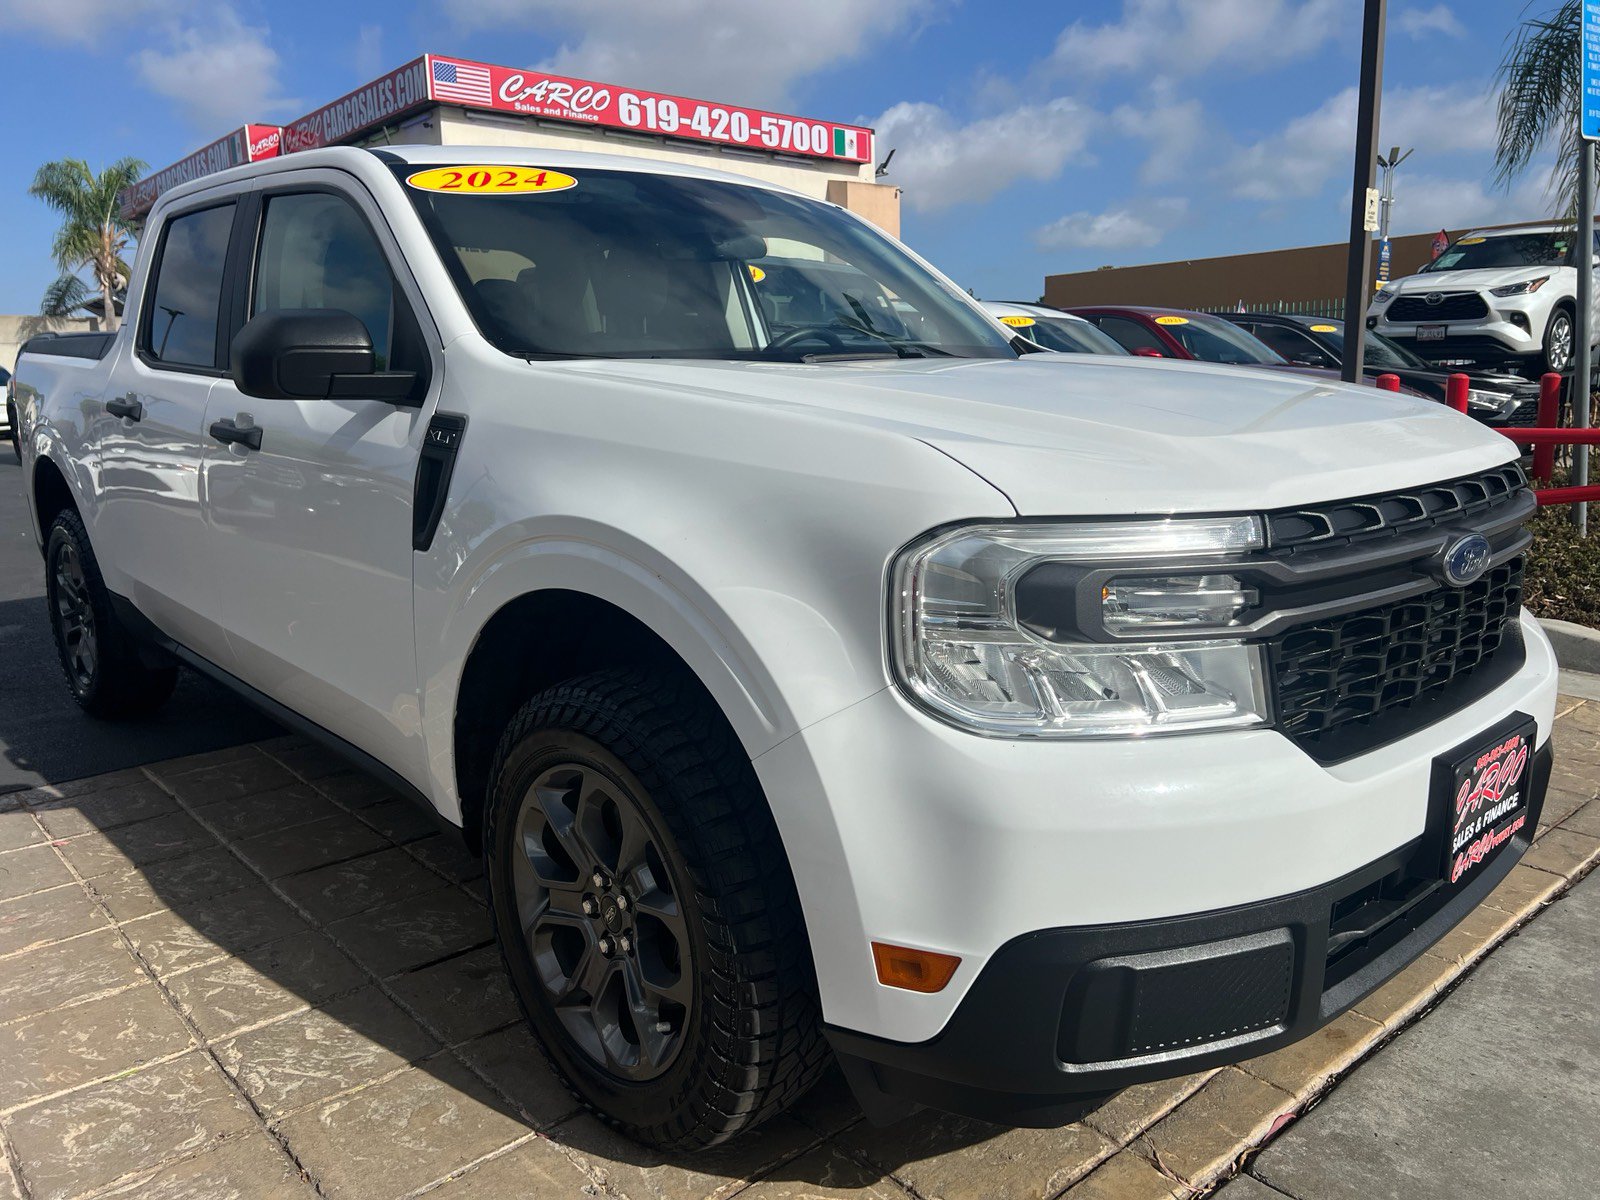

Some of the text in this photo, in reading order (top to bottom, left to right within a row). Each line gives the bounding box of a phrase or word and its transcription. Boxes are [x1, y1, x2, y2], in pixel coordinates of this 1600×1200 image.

[323, 62, 427, 142] CARCOSALES.COM
[498, 74, 829, 154] CARCO 619-420-5700
[514, 101, 599, 122] Sales and Finance
[250, 132, 280, 155] CARCO
[156, 139, 231, 196] CARCOSALES.COM
[439, 171, 548, 189] 2024
[1461, 547, 1487, 576] Ford
[1452, 791, 1520, 854] SALES & FINANCE
